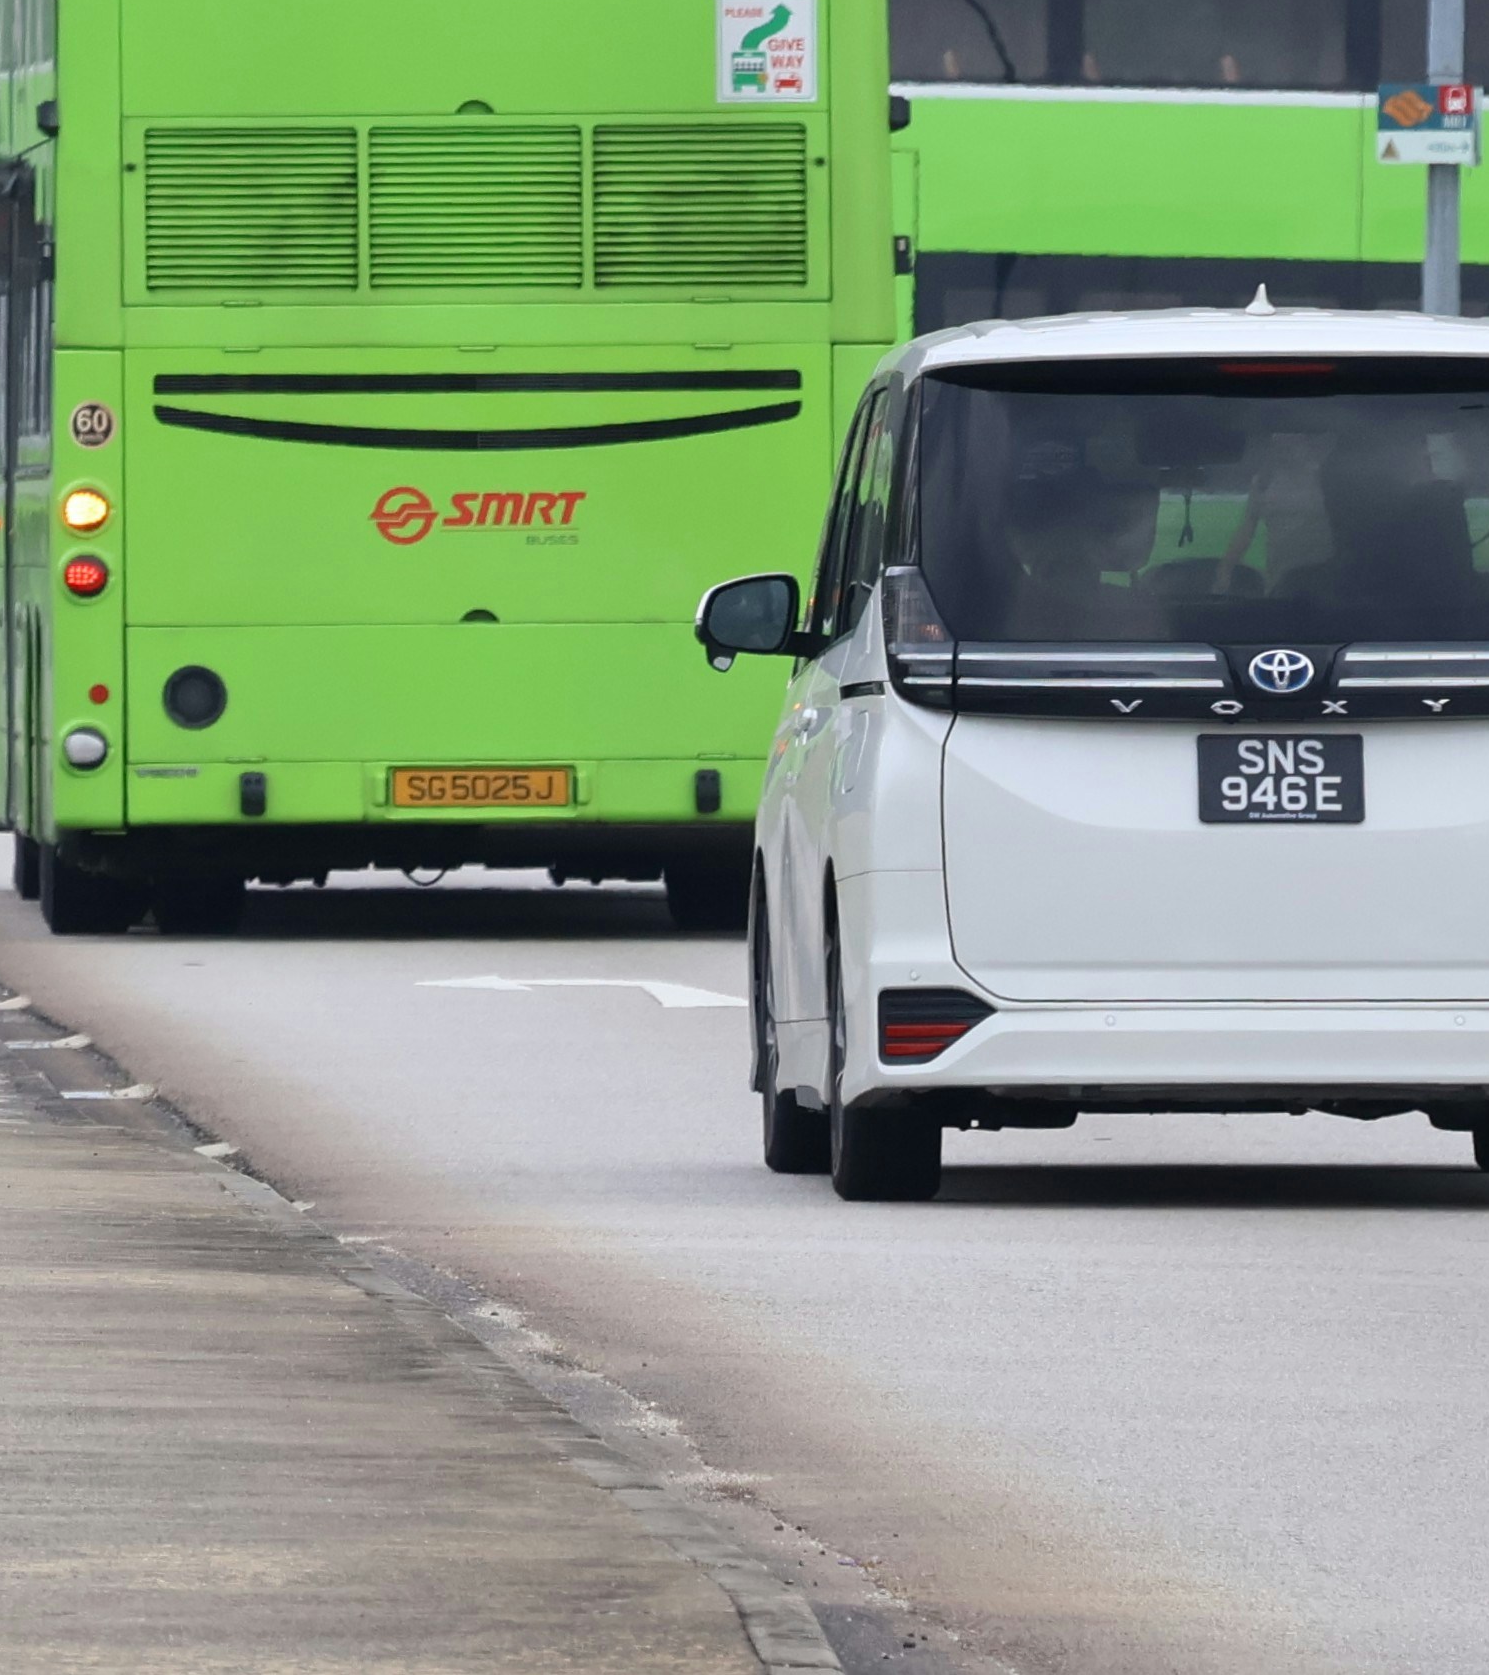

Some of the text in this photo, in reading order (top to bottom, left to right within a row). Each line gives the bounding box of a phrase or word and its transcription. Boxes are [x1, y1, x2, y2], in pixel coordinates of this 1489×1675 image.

[724, 7, 763, 18] PLEASE
[767, 37, 805, 52] GIVE
[770, 55, 804, 69] WAY
[75, 408, 109, 433] 60
[442, 491, 587, 526] SMRT
[525, 534, 579, 546] BUSES
[1110, 699, 1451, 715] VOXY
[1237, 739, 1325, 775] SNS
[407, 775, 554, 801] SG5025J
[1221, 776, 1343, 811] 946E
